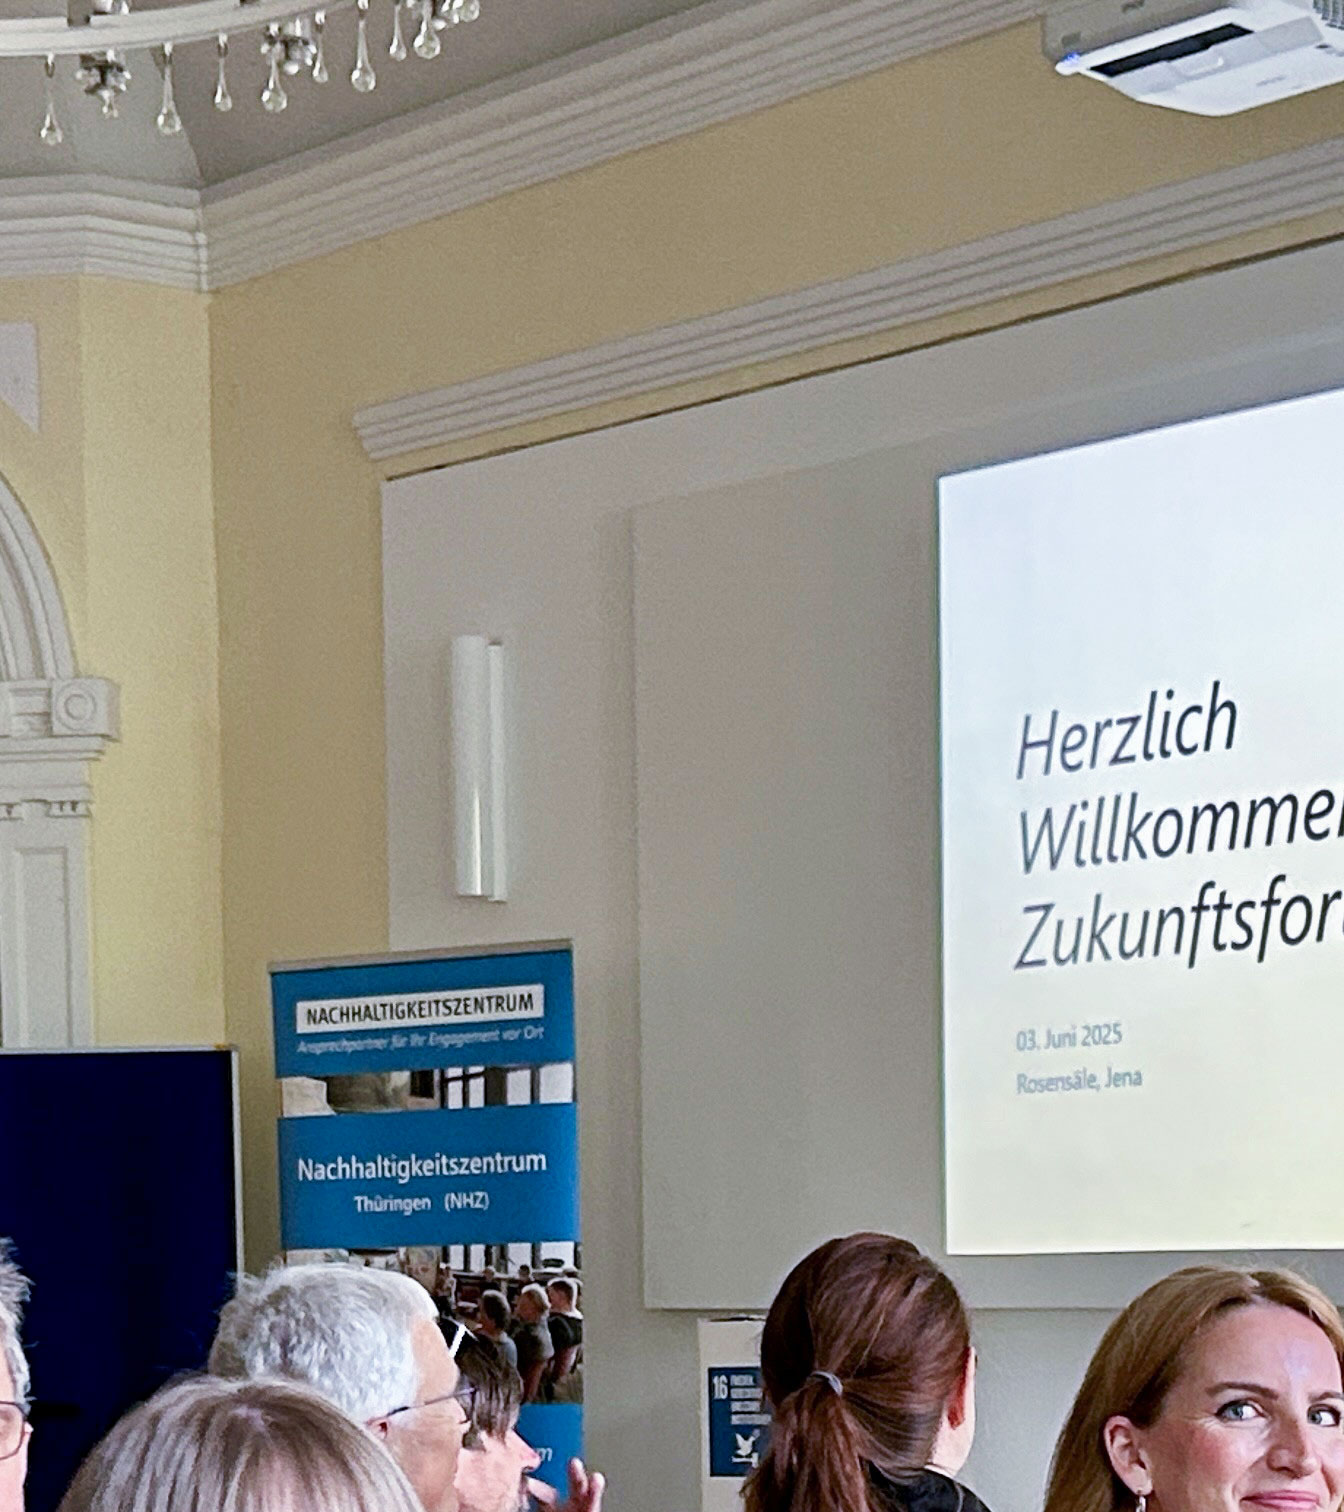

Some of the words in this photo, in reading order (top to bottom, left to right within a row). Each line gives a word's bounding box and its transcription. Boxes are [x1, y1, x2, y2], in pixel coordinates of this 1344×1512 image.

[1016, 679, 1238, 780] Herzlich
[306, 992, 534, 1026] NACHHALTIGKEITSZENTRUM
[524, 1025, 545, 1040] Ort
[1016, 1028, 1041, 1051] 03.
[1044, 1024, 1077, 1050] Juni
[1081, 1022, 1123, 1047] 2025
[1016, 1066, 1101, 1095] Rosensäle,
[1104, 1066, 1143, 1088] Jena
[298, 1152, 547, 1183] Nachhaltigkeitszentrum
[354, 1193, 431, 1215] Thüringen
[444, 1191, 489, 1211] (NHZ)
[713, 1374, 729, 1400] 16
